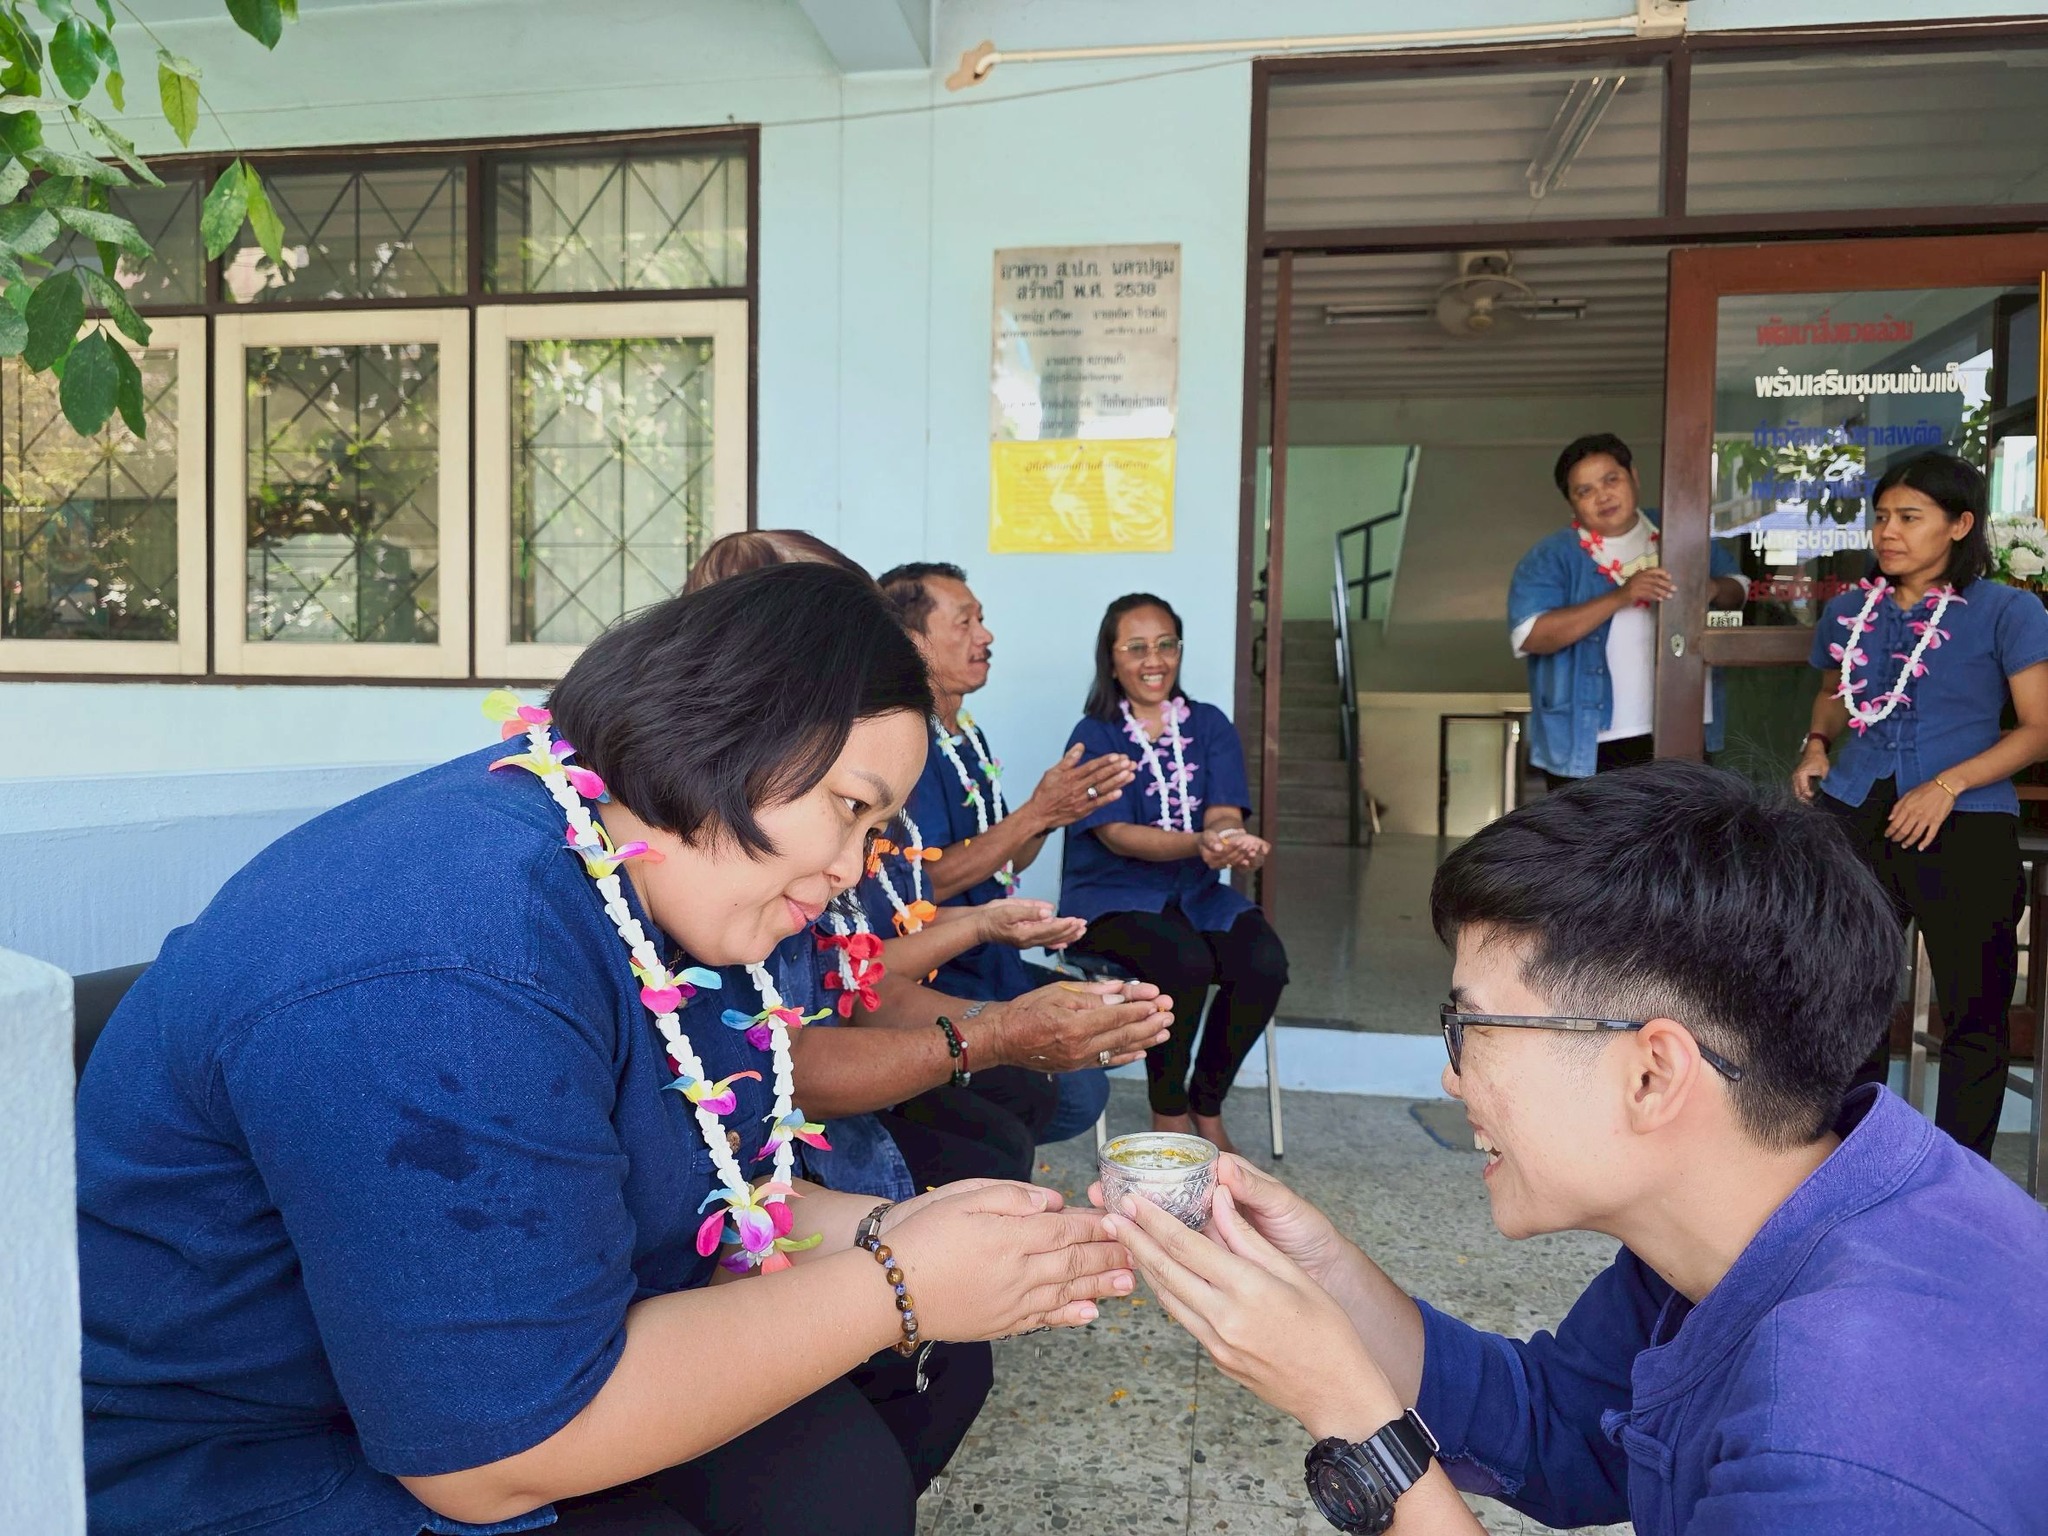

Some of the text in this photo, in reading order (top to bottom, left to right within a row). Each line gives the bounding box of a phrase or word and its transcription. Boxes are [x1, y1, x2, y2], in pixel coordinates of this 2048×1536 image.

[1755, 362, 1969, 403] พร้อมเสริมชุมชนเข้มแข็ง
